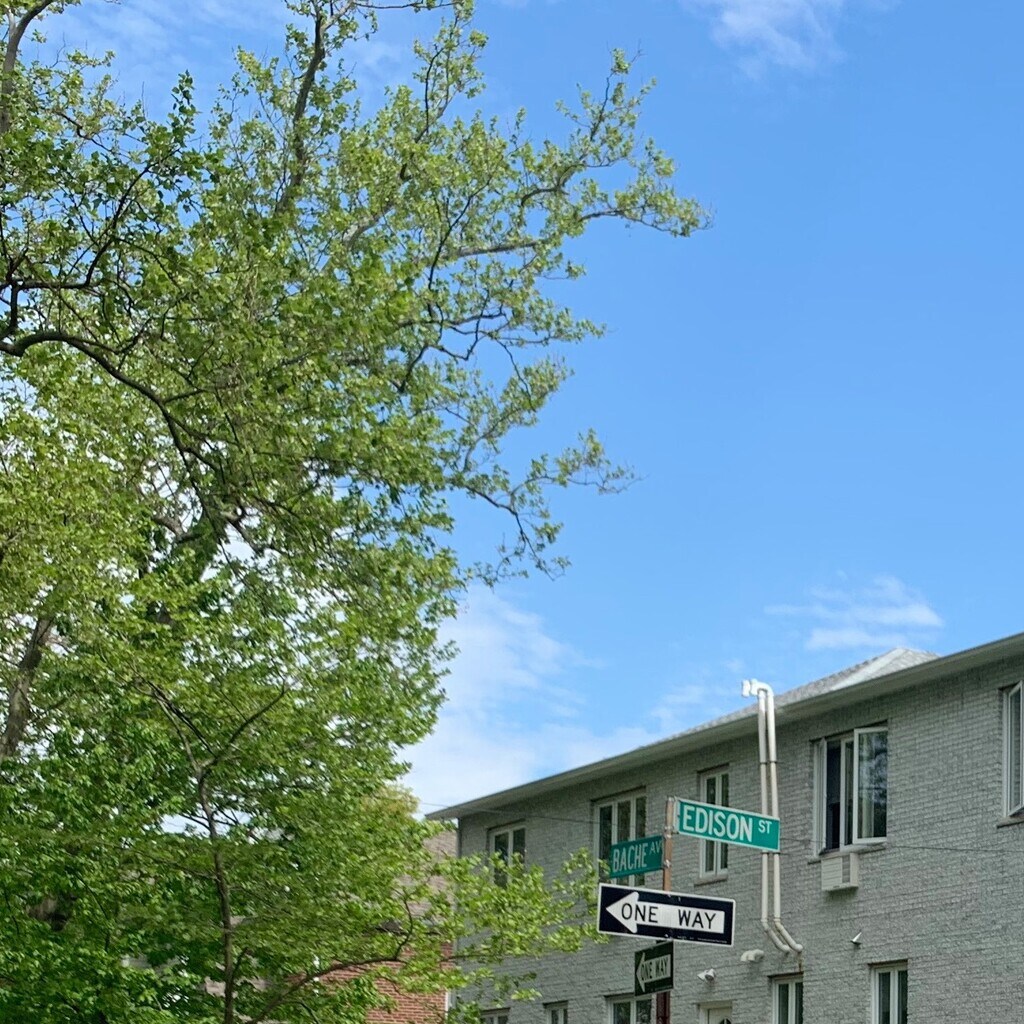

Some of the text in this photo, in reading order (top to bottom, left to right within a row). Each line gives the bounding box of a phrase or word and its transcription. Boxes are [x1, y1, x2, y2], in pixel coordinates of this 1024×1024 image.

[682, 805, 772, 842] EDISON ST
[612, 843, 647, 873] BACHE
[621, 903, 717, 929] ONE WAY
[641, 957, 669, 981] ONE WAY
